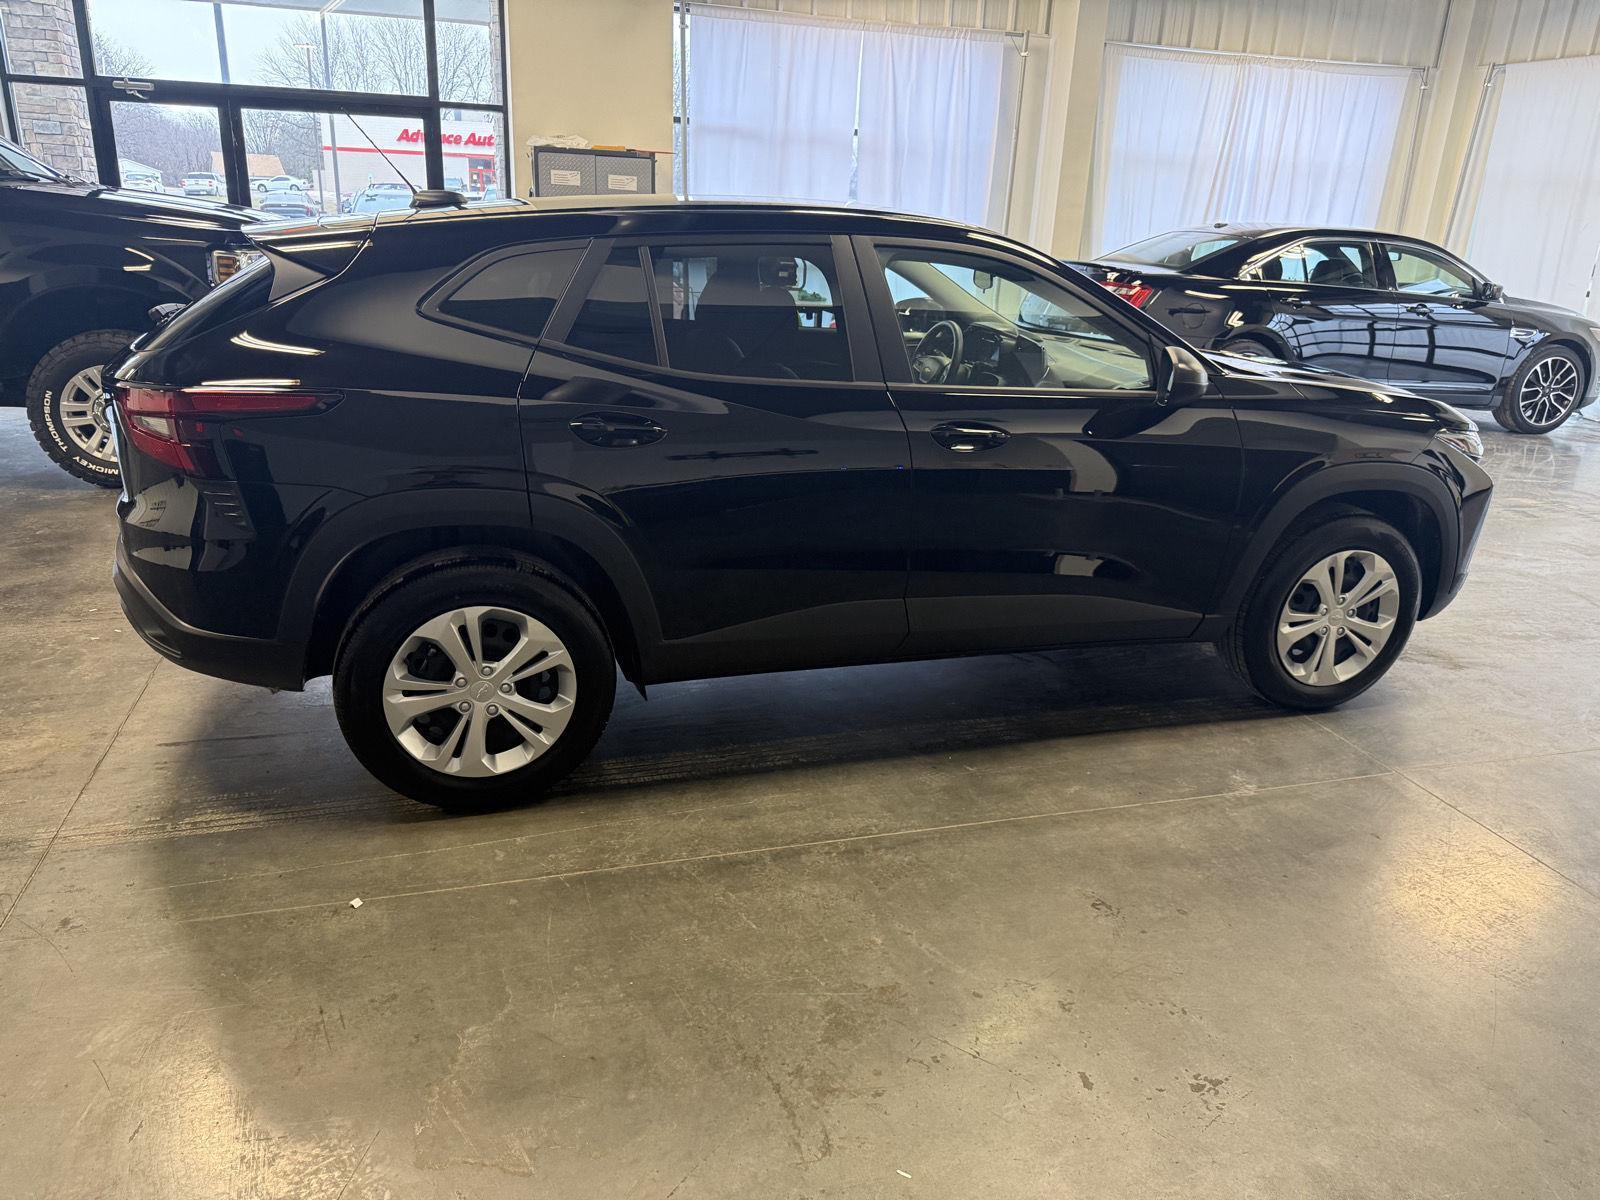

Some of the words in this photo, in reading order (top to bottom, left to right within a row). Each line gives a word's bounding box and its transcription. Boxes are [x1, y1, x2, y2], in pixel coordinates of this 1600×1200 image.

[464, 132, 495, 147] Aut
[43, 390, 68, 453] THOMPSON
[72, 456, 119, 475] MICKEY
